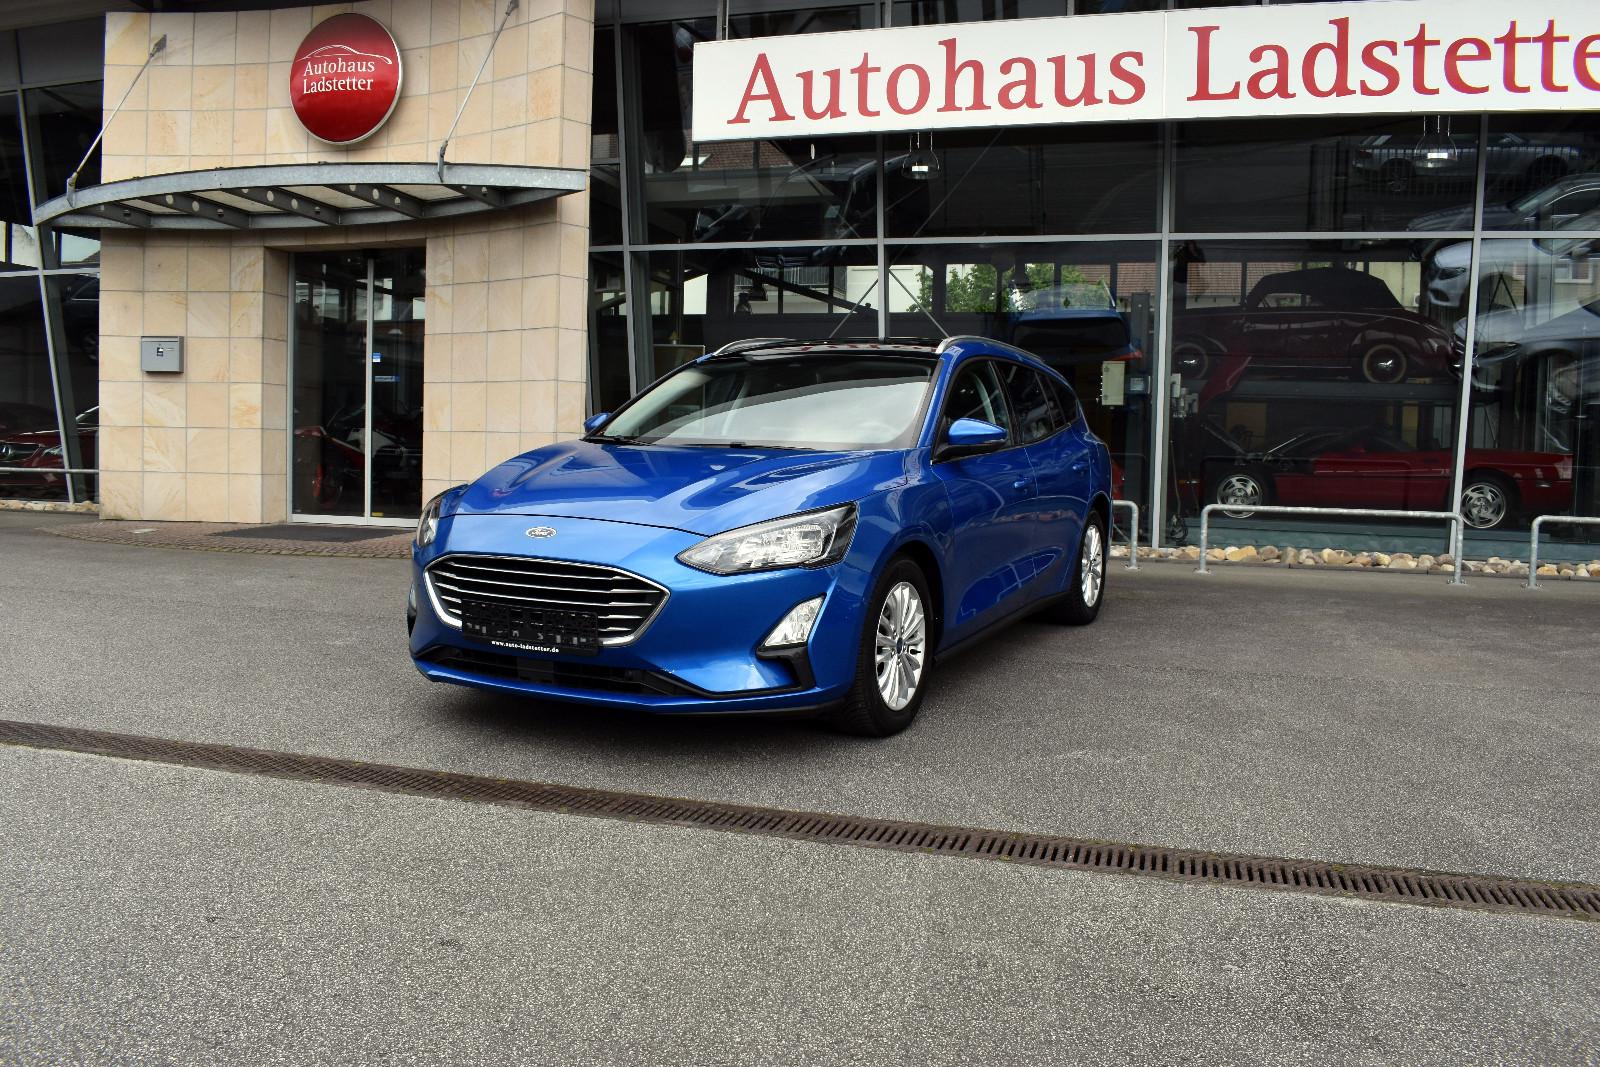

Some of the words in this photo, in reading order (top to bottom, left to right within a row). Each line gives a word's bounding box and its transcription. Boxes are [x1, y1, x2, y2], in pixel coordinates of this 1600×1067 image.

[303, 57, 375, 77] Autohaus
[303, 76, 374, 94] Ladstetter
[726, 37, 1146, 125] Autohaus
[491, 640, 560, 653] www.auto-ladstetter.de
